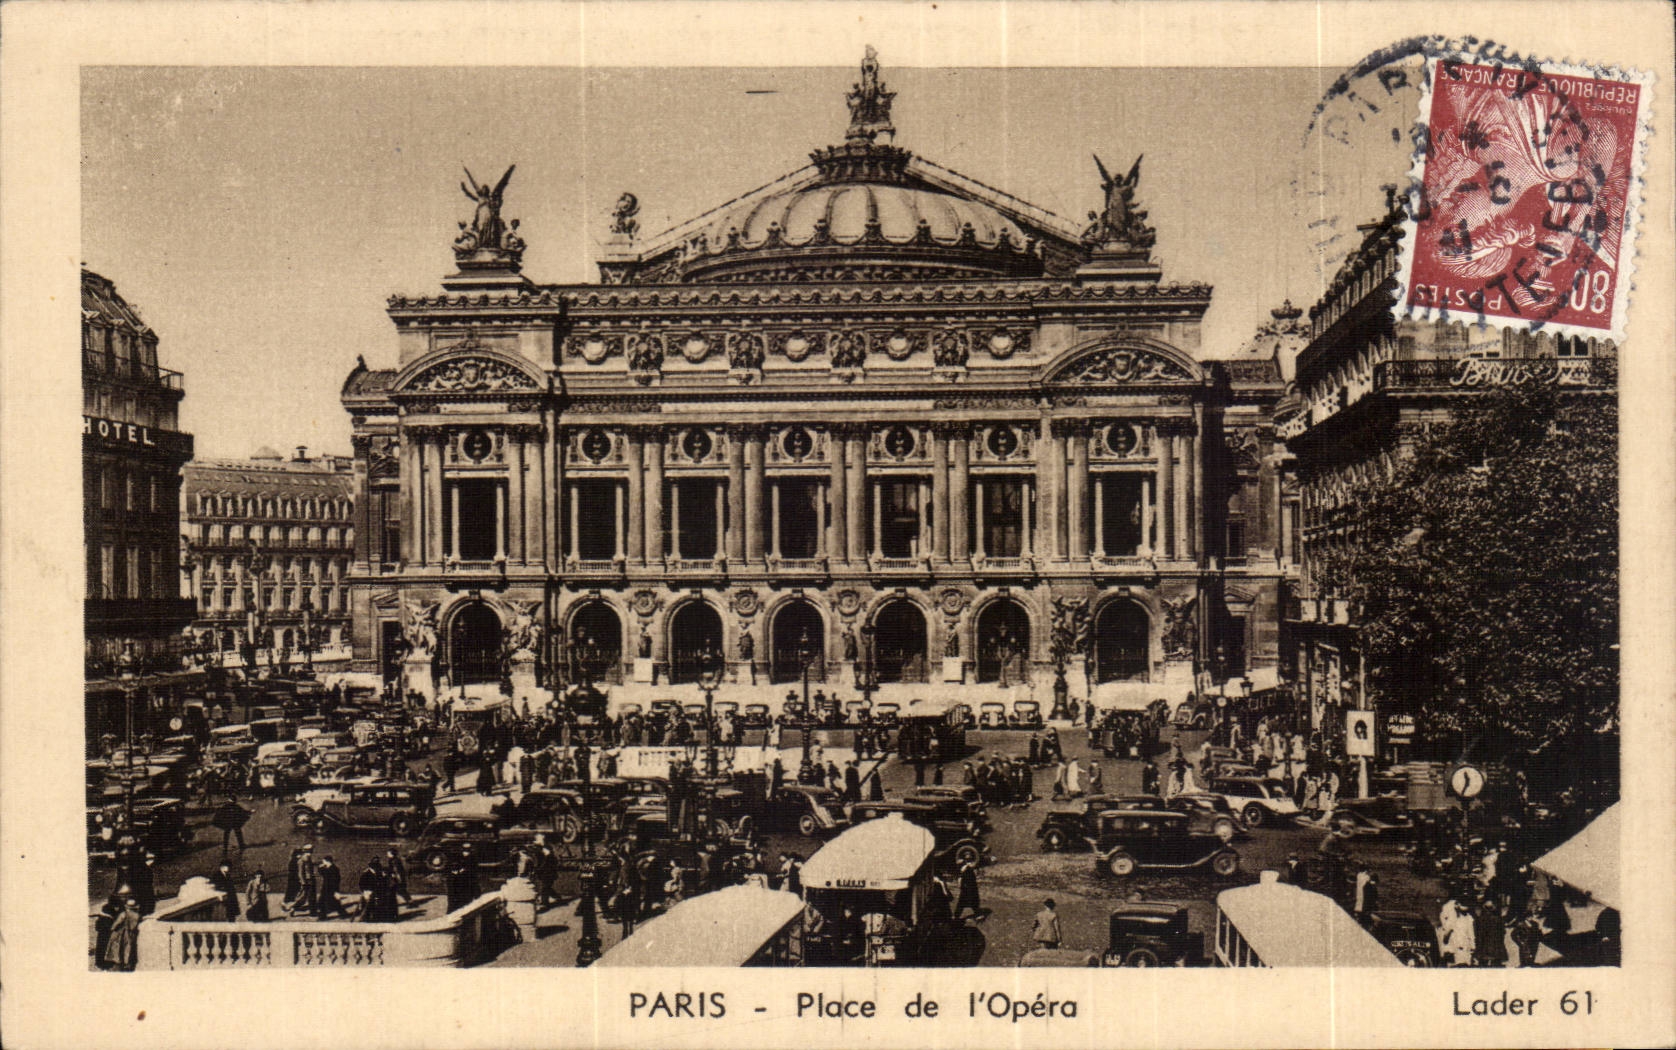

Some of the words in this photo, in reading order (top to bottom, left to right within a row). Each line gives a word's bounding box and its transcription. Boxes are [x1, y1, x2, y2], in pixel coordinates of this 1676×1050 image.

[1415, 283, 1502, 310] POSTES
[1570, 270, 1611, 313] 80
[81, 416, 155, 446] HOTEL
